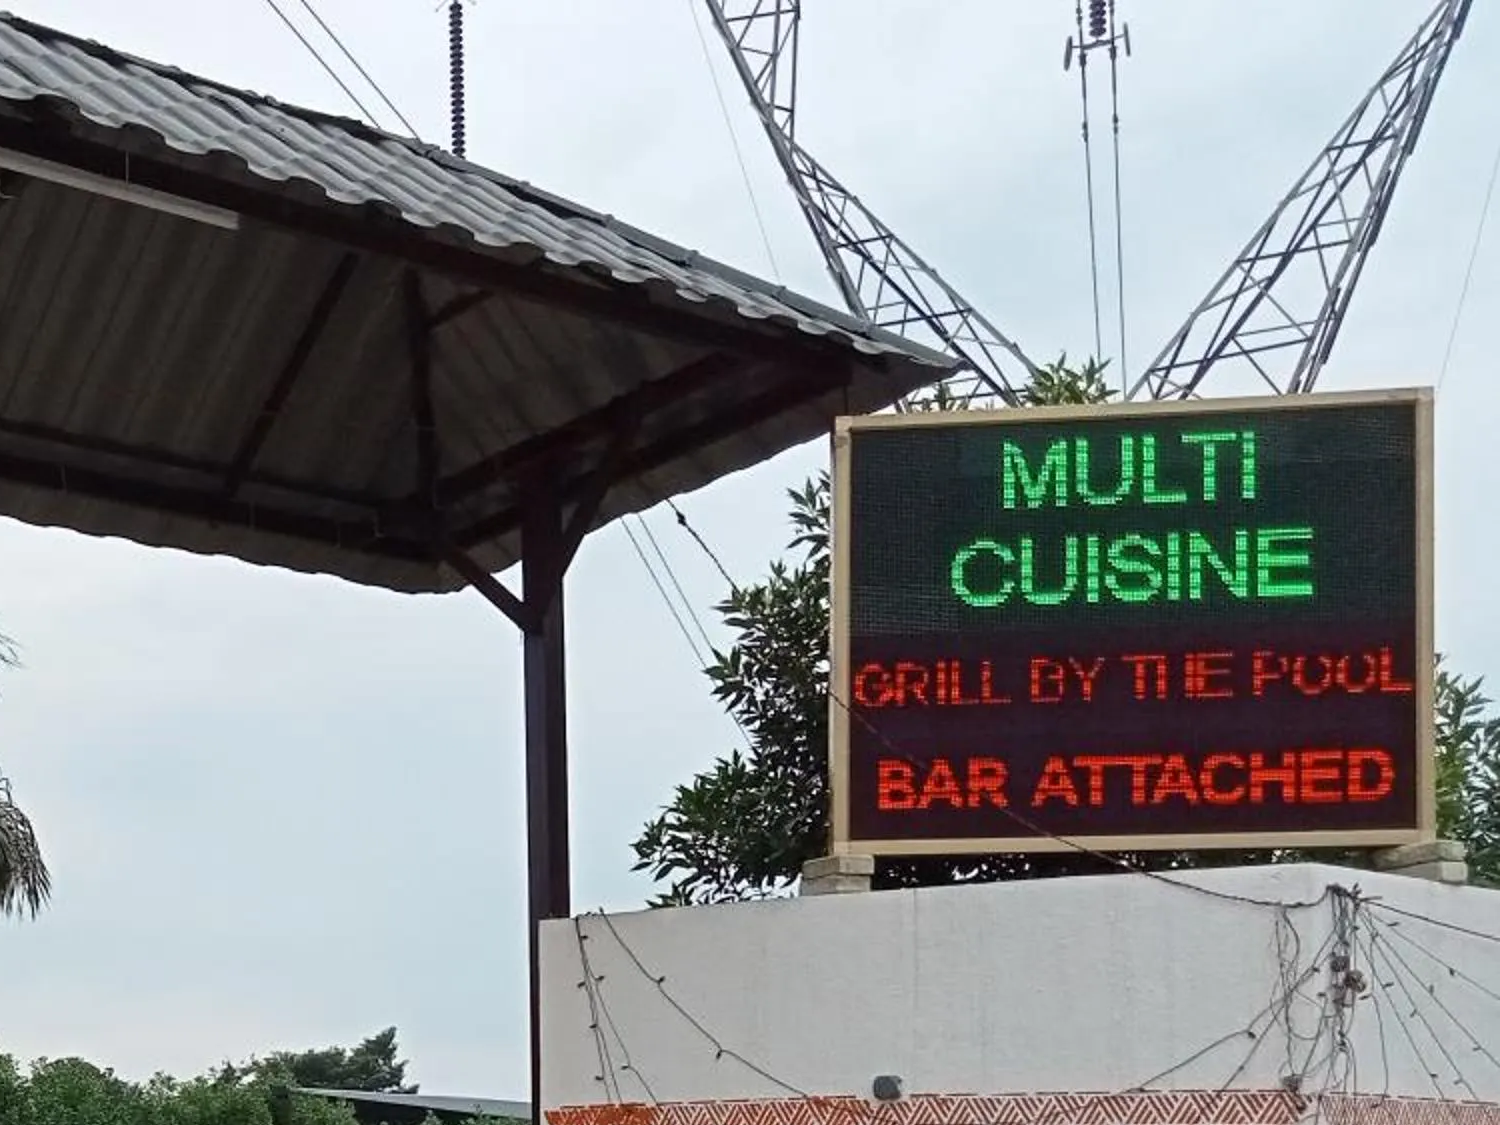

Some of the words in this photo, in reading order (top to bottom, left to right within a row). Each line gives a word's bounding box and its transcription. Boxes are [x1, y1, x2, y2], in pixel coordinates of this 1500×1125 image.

[1003, 431, 1257, 508] MULTI
[952, 526, 1314, 606] CUISINE
[853, 662, 1012, 705] GRILL
[1030, 656, 1105, 702] BY
[1252, 648, 1413, 696] POOL
[877, 757, 1008, 810] BAR
[1033, 748, 1395, 806] ATTACHED
